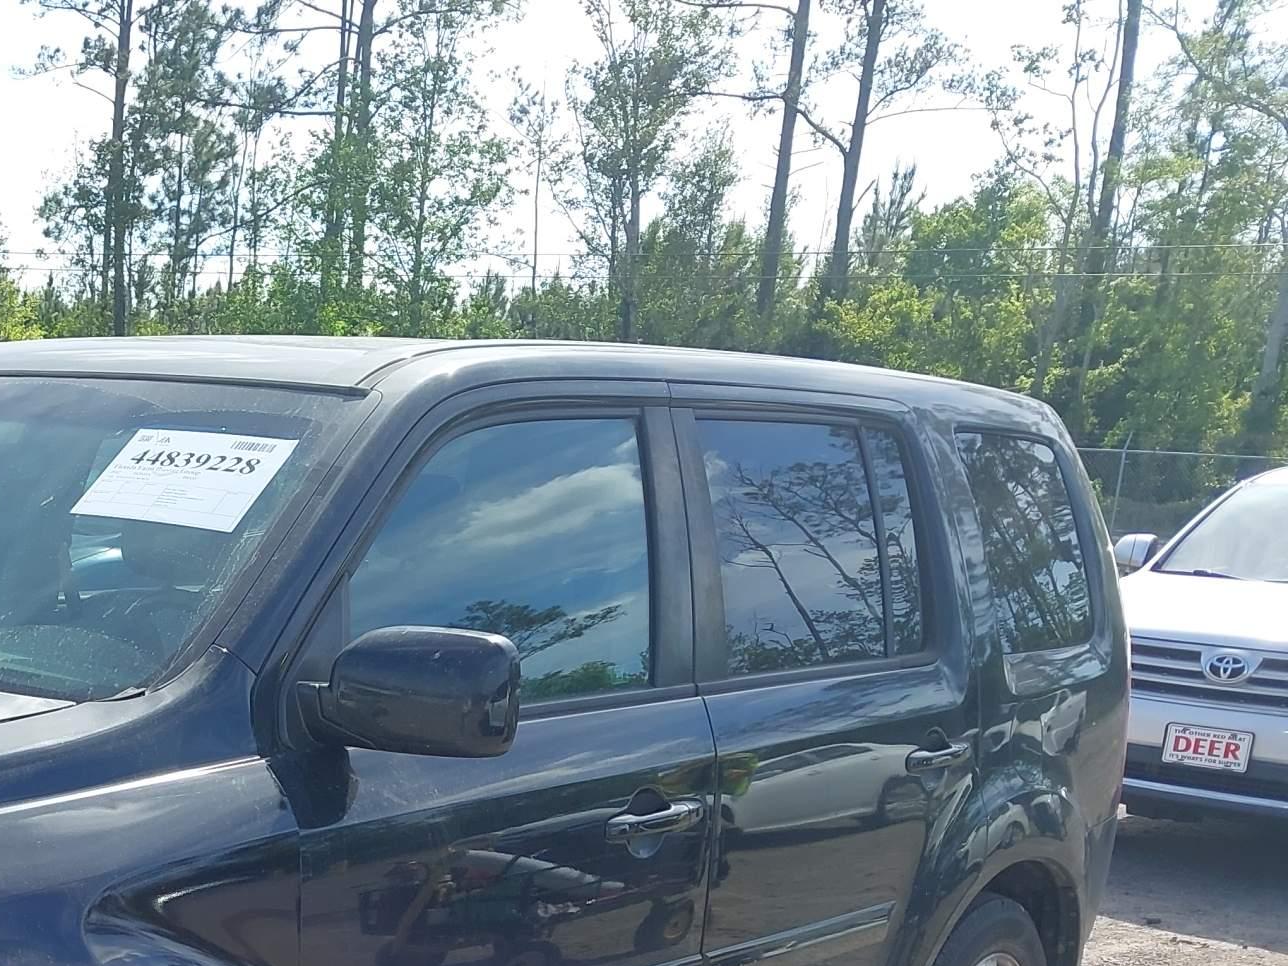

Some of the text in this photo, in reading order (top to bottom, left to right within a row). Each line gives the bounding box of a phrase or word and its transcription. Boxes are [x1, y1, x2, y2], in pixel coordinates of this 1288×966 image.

[130, 449, 261, 475] 44839228
[1189, 729, 1211, 737] OTHER
[1172, 735, 1241, 760] DEER
